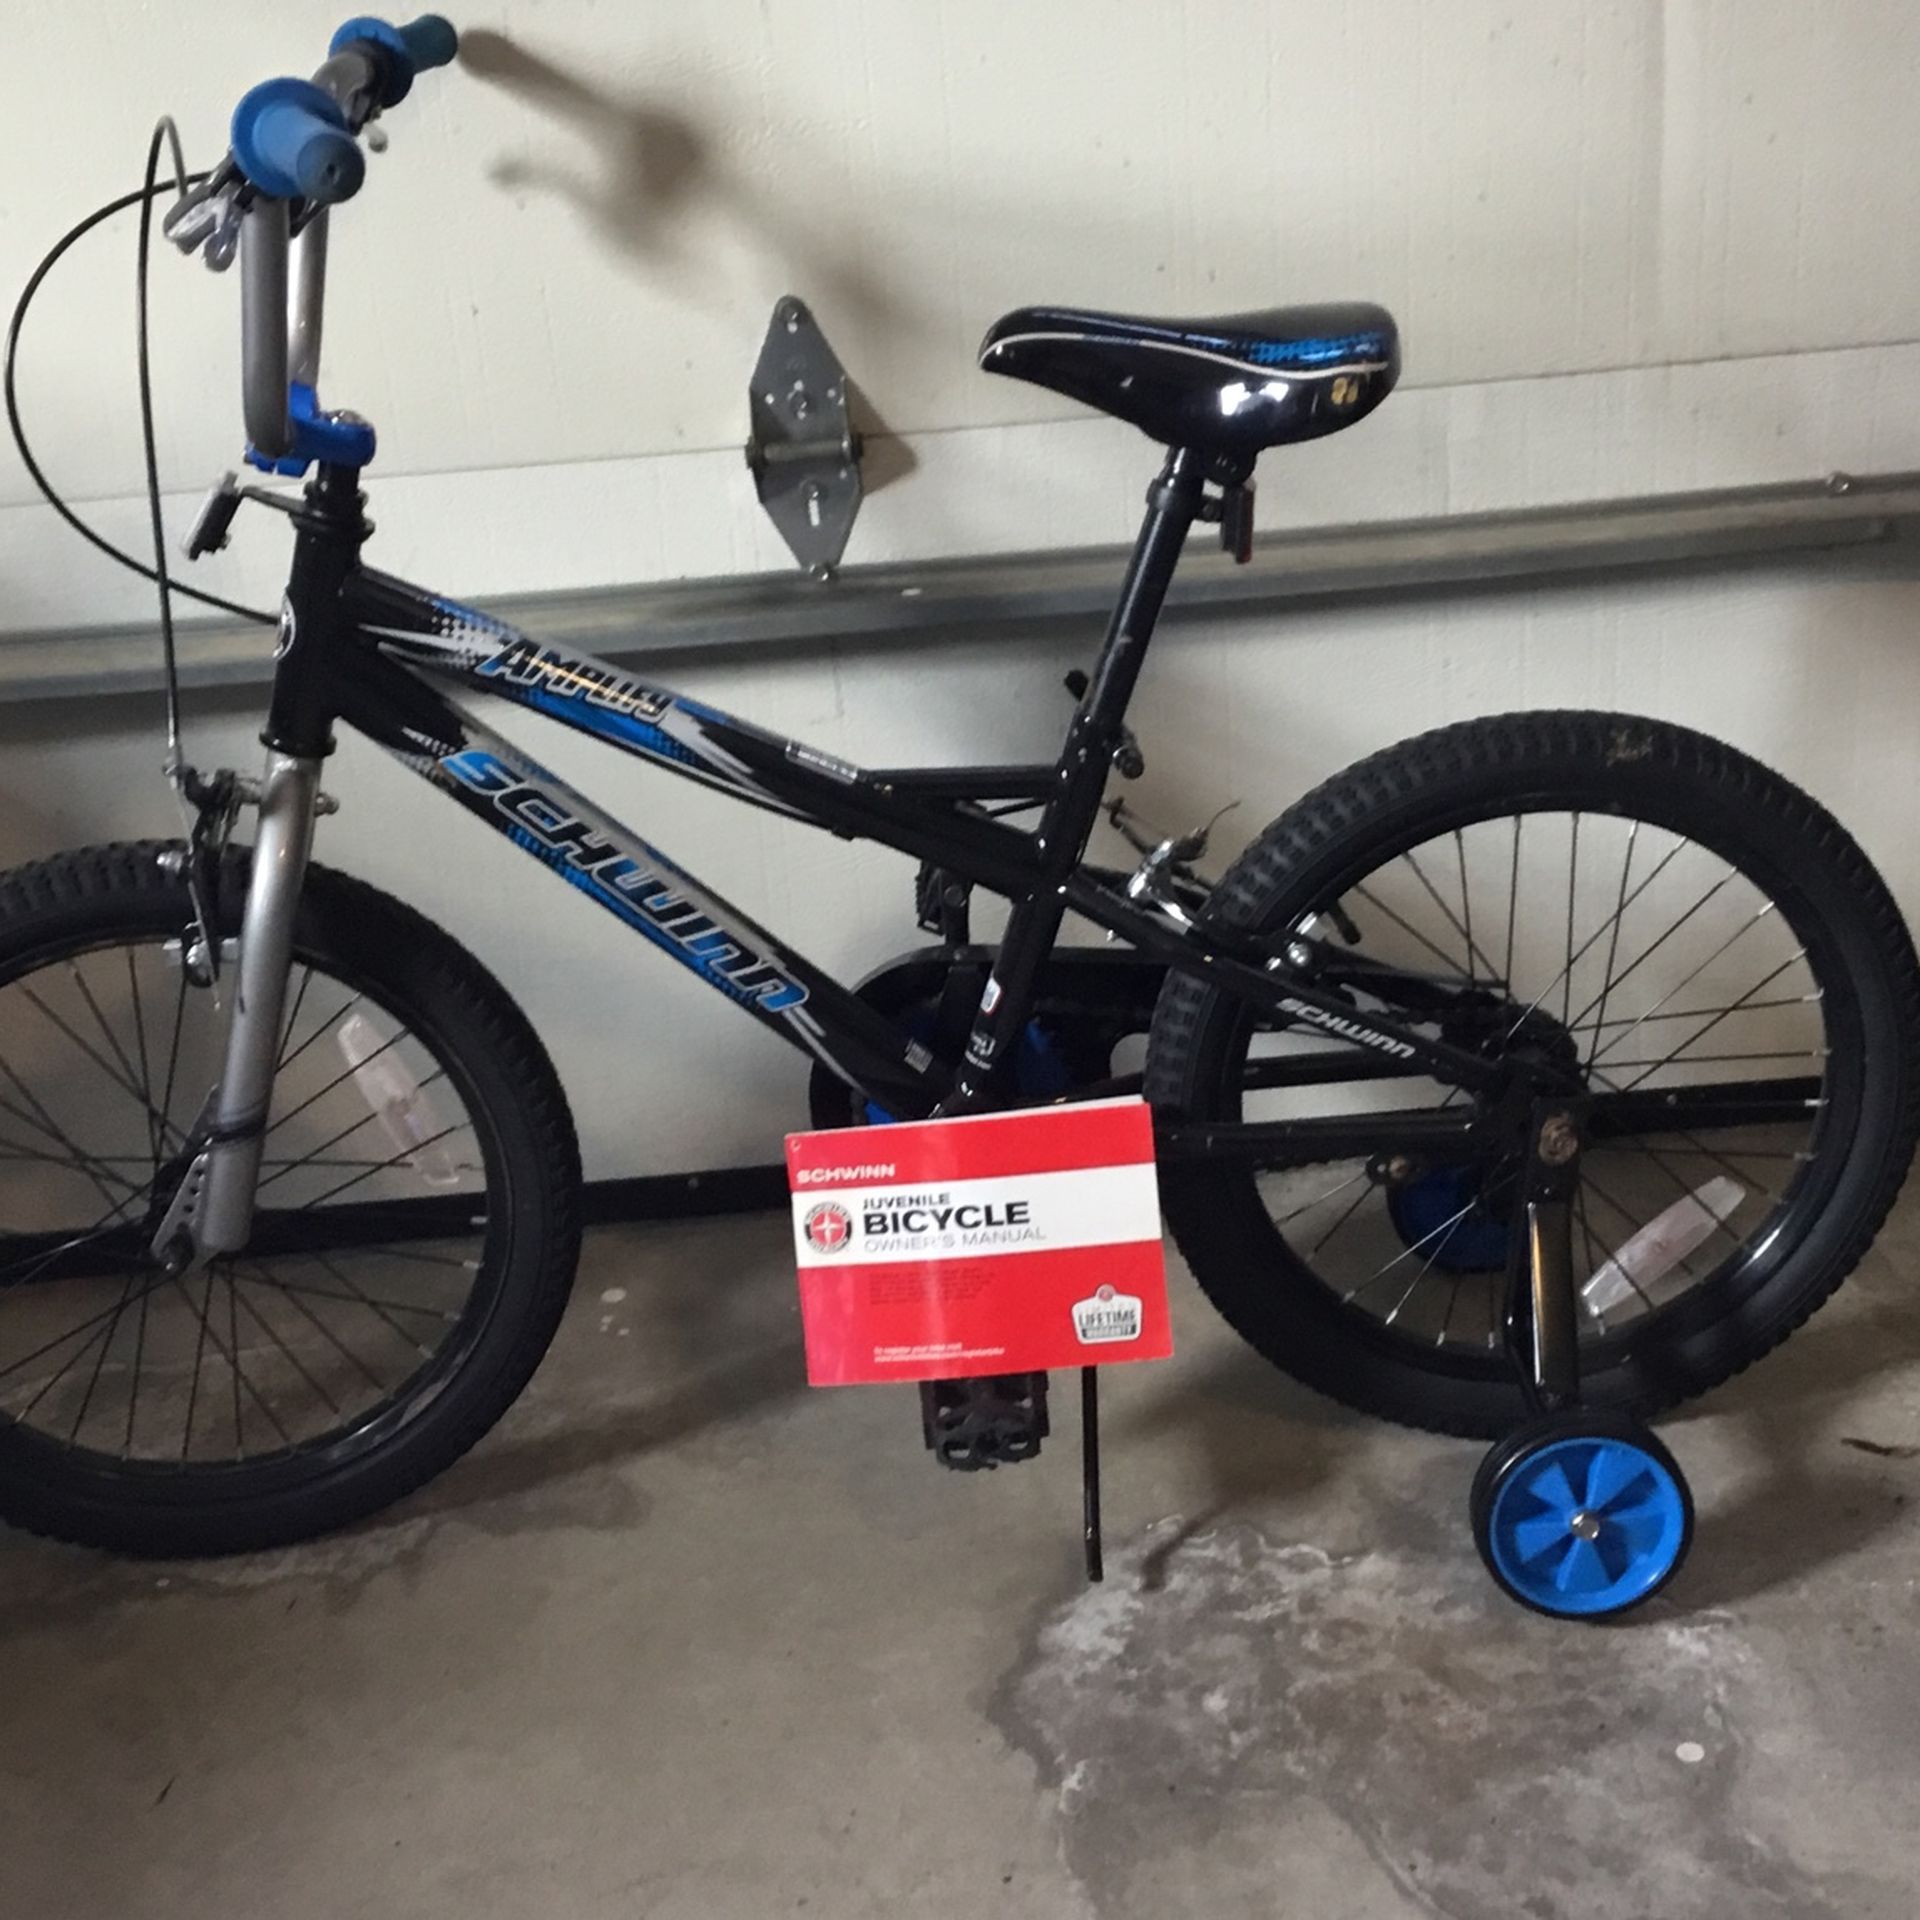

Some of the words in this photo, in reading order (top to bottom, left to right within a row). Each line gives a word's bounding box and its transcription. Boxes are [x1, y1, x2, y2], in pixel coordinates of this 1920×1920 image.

[439, 750, 810, 1012] SCHWINN
[1276, 998, 1416, 1058] SCHWINN
[797, 1164, 895, 1184] SCHWINN
[863, 1192, 951, 1210] JUVENILE
[863, 1201, 1031, 1236] BICYCLE
[864, 1233, 956, 1254] OWNER'S
[962, 1226, 1048, 1246] MANUAL
